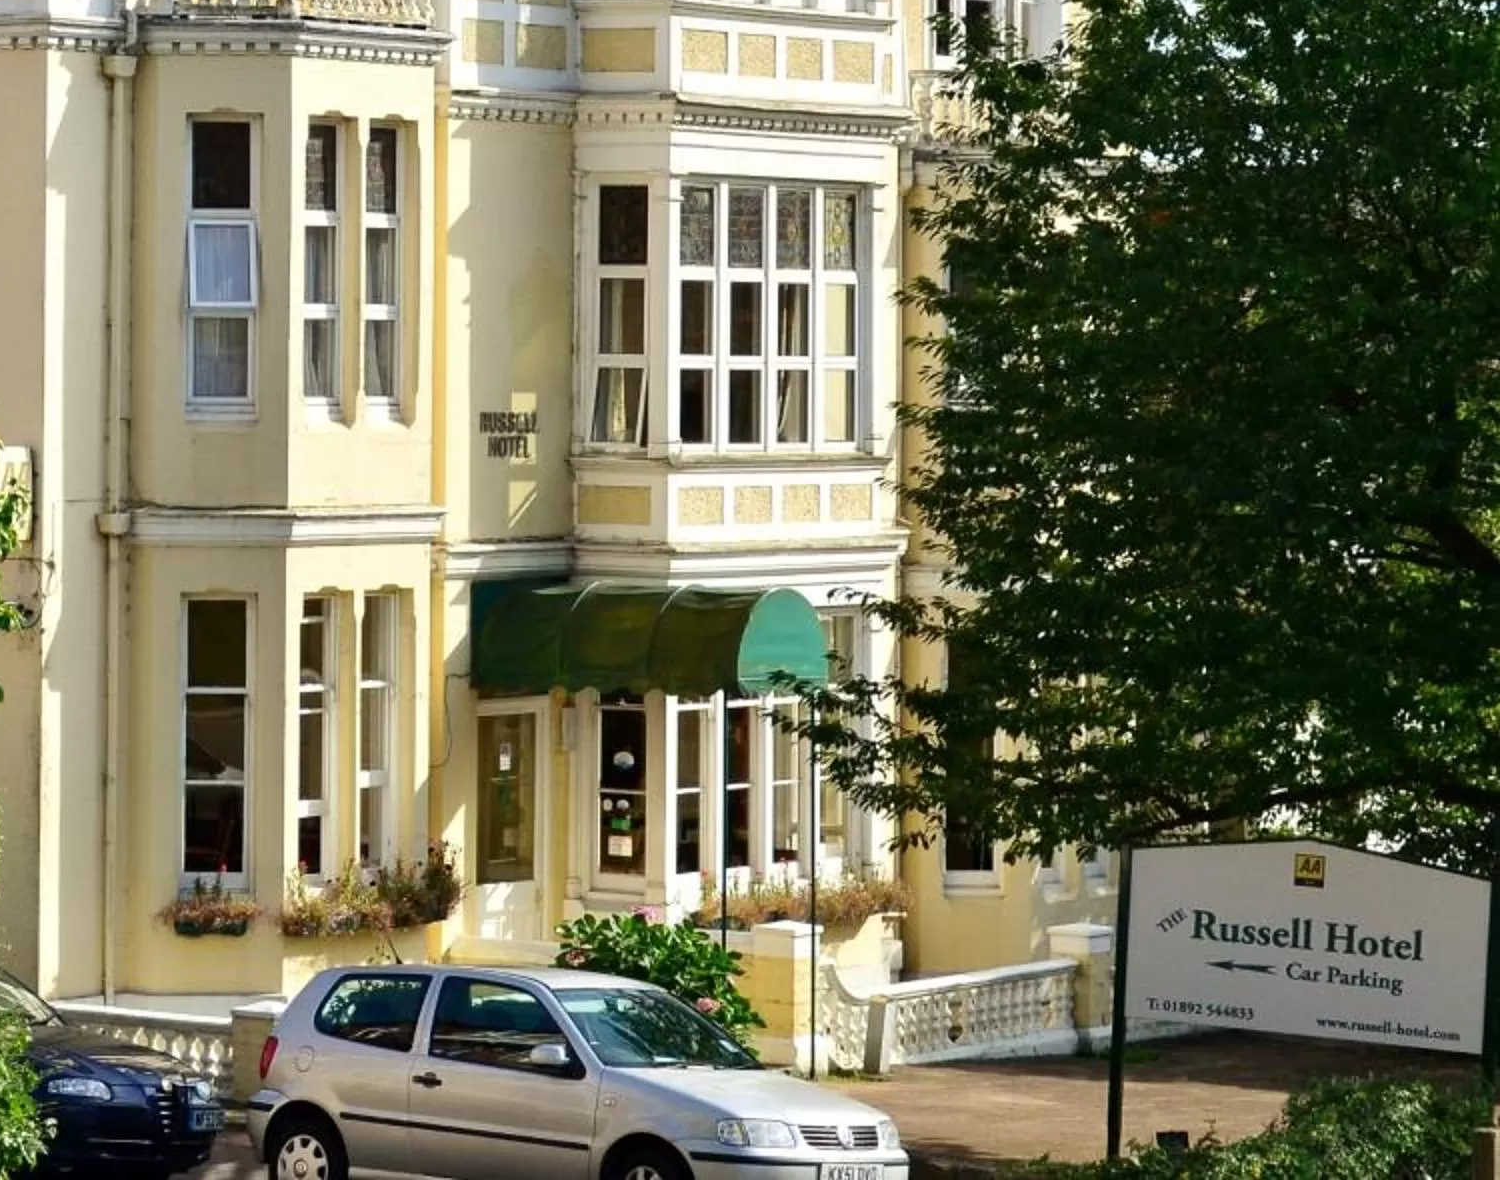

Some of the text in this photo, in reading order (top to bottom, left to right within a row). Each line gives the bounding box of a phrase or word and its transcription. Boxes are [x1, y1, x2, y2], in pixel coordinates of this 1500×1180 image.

[487, 435, 532, 458] HOTEL
[1299, 858, 1321, 875] AA
[1156, 908, 1424, 961] THE Russell Hotel
[1285, 962, 1403, 996] Car Parking
[1163, 999, 1202, 1014] 01892
[1316, 1017, 1460, 1041] www.russell-hotel.com
